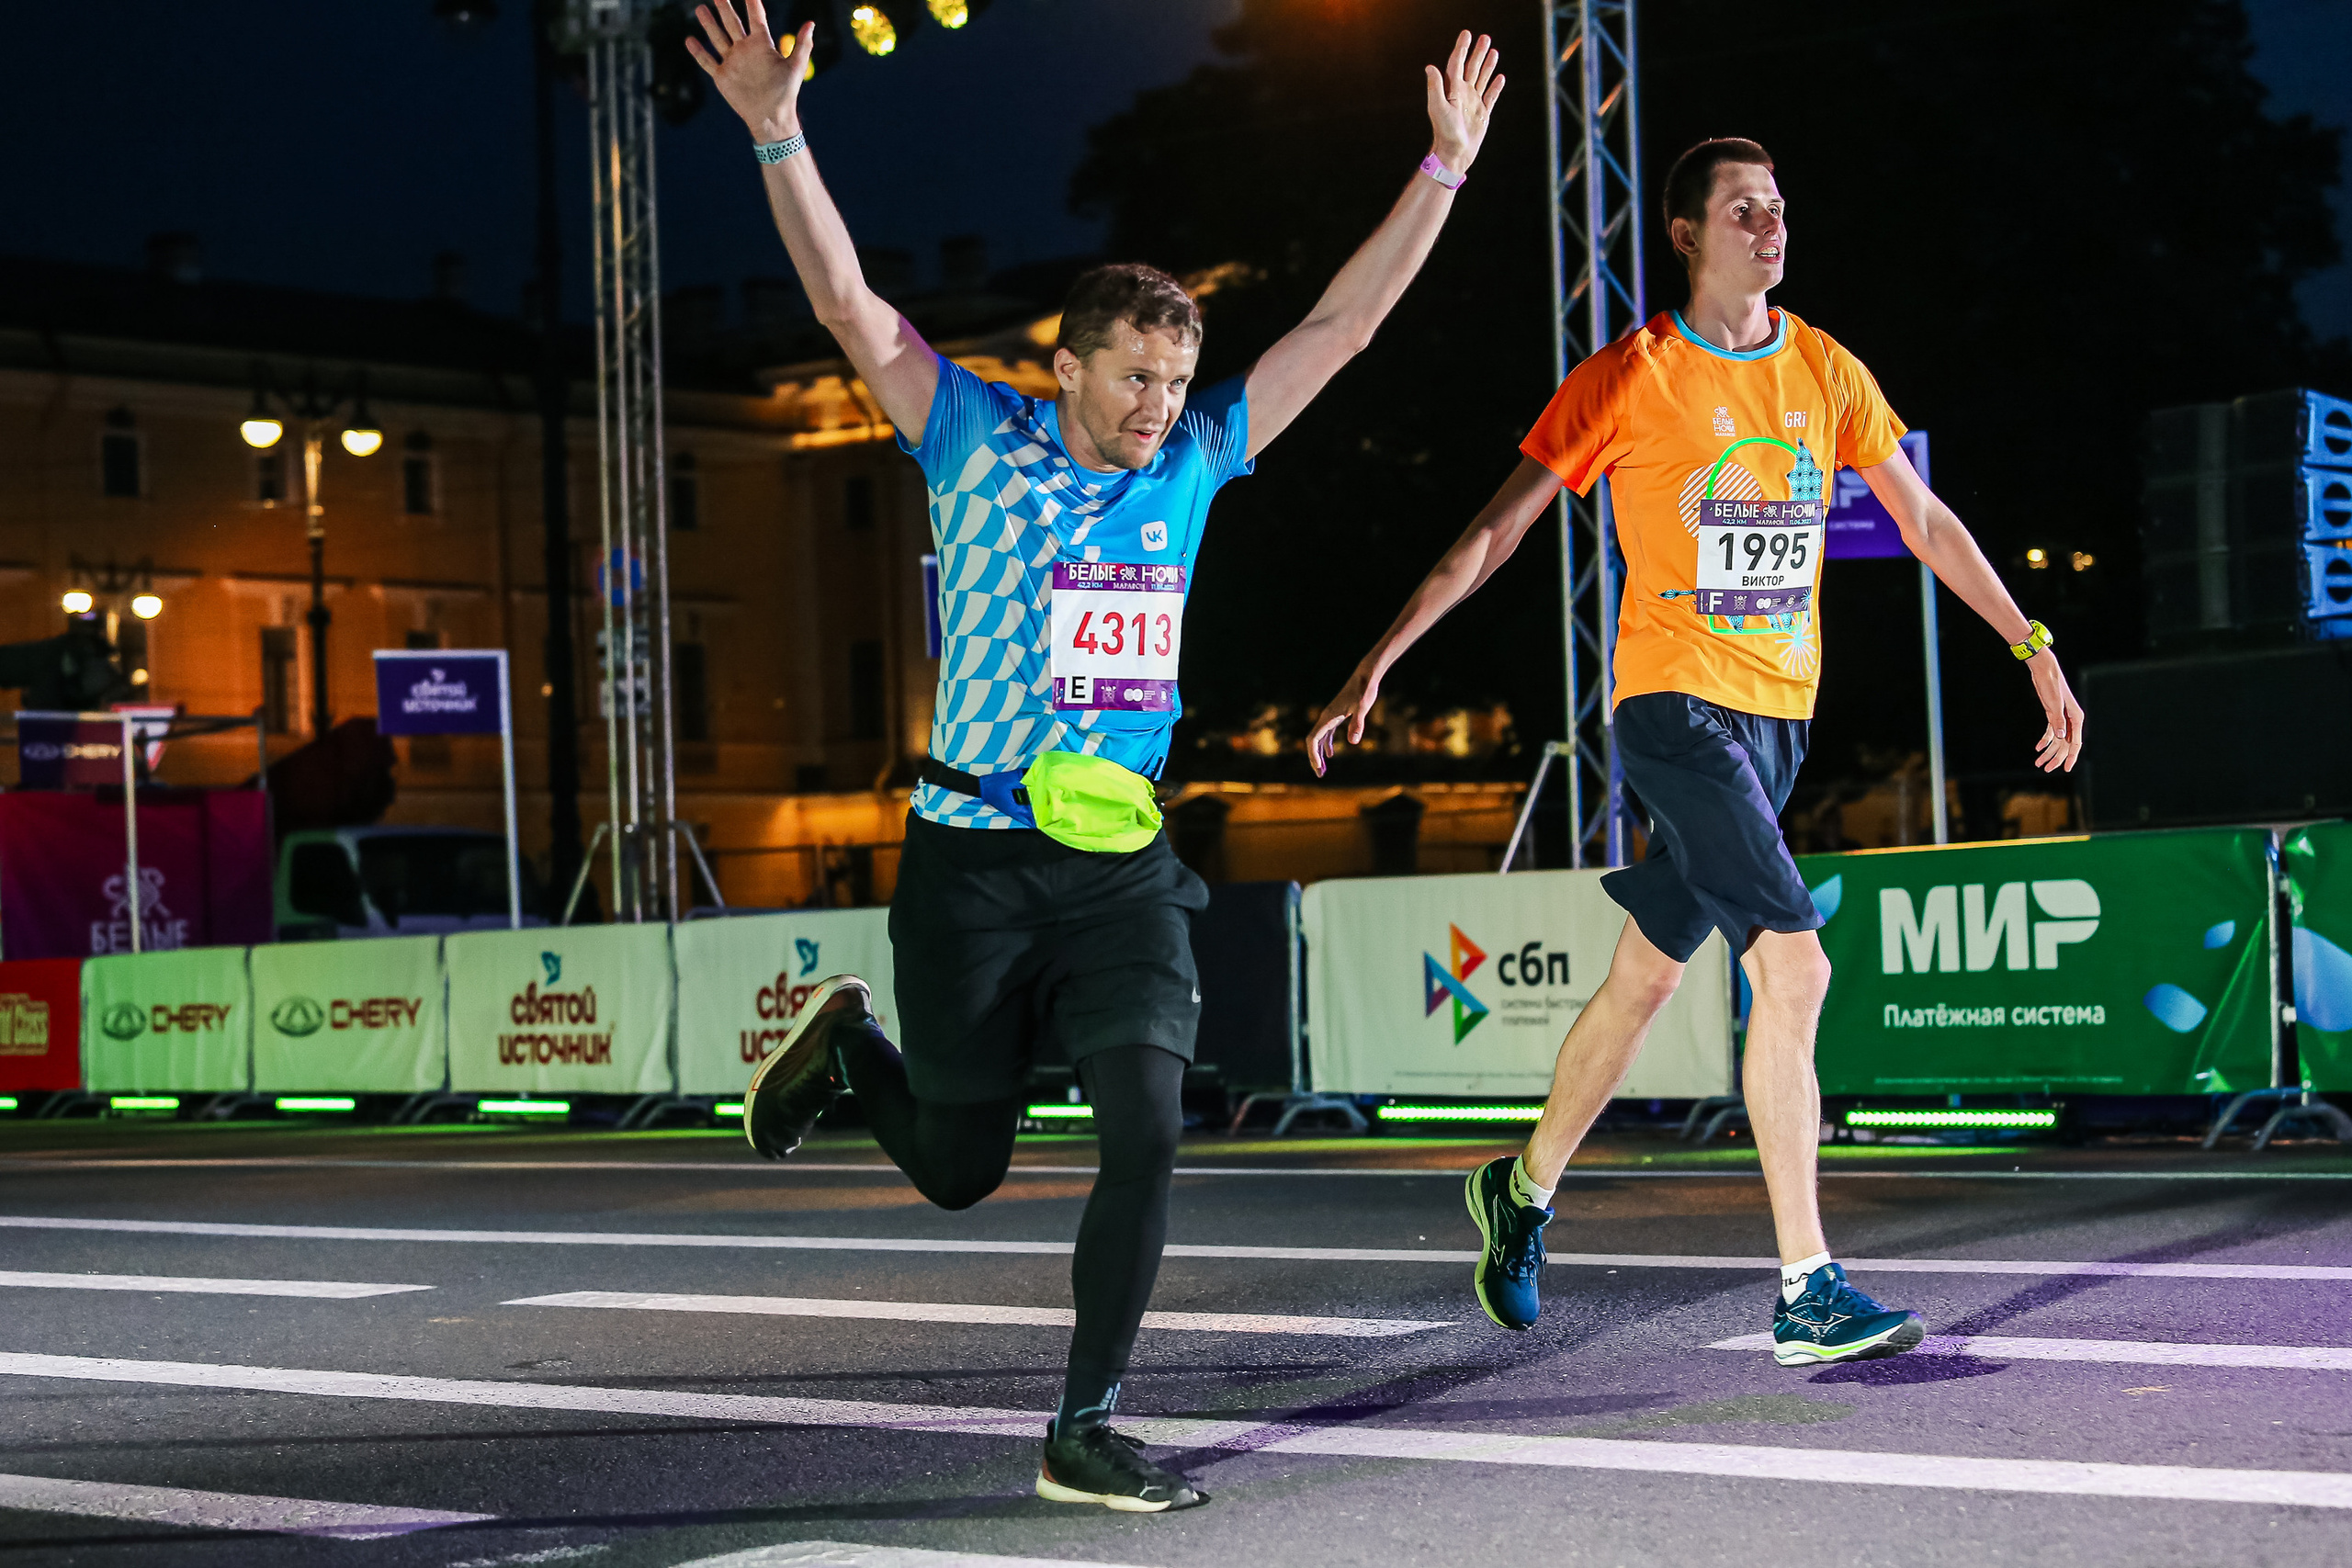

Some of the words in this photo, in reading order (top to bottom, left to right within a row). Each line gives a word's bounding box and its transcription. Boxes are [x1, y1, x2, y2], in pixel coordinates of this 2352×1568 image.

[1784, 412, 1806, 428] GRi
[1714, 503, 1760, 518] БЕЛЫЕ
[1781, 502, 1815, 519] НОЧИ
[1718, 532, 1810, 571] 1995
[1069, 563, 1117, 581] БЕЛЫЕ
[1142, 566, 1179, 583] НОЧИ
[1742, 575, 1785, 587] ВИКТОР
[1708, 592, 1724, 612] F
[1073, 611, 1172, 657] 4313
[1071, 676, 1087, 699] E
[1879, 879, 2101, 974] МИР
[1498, 941, 1570, 987] сбп
[153, 1003, 232, 1032] CHERY
[331, 997, 422, 1031] CHERY
[1884, 1002, 2005, 1028] Платёжная
[2011, 1003, 2105, 1026] система
